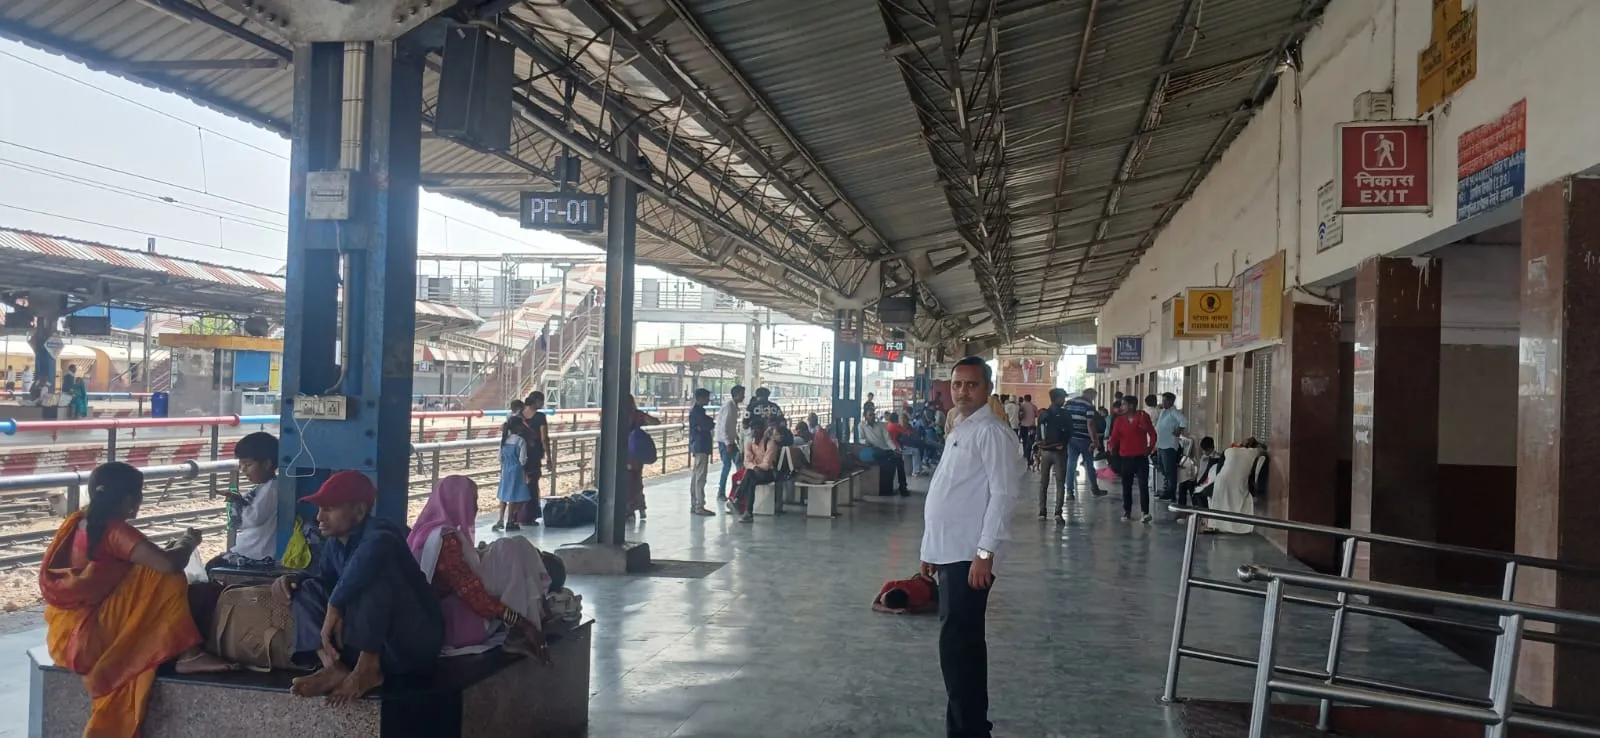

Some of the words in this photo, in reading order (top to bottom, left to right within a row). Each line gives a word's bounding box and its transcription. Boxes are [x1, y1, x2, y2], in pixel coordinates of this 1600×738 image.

[1354, 171, 1415, 188] निकास
[1360, 189, 1408, 203] EXIT
[531, 198, 588, 224] PF-01
[886, 342, 903, 350] PF-01
